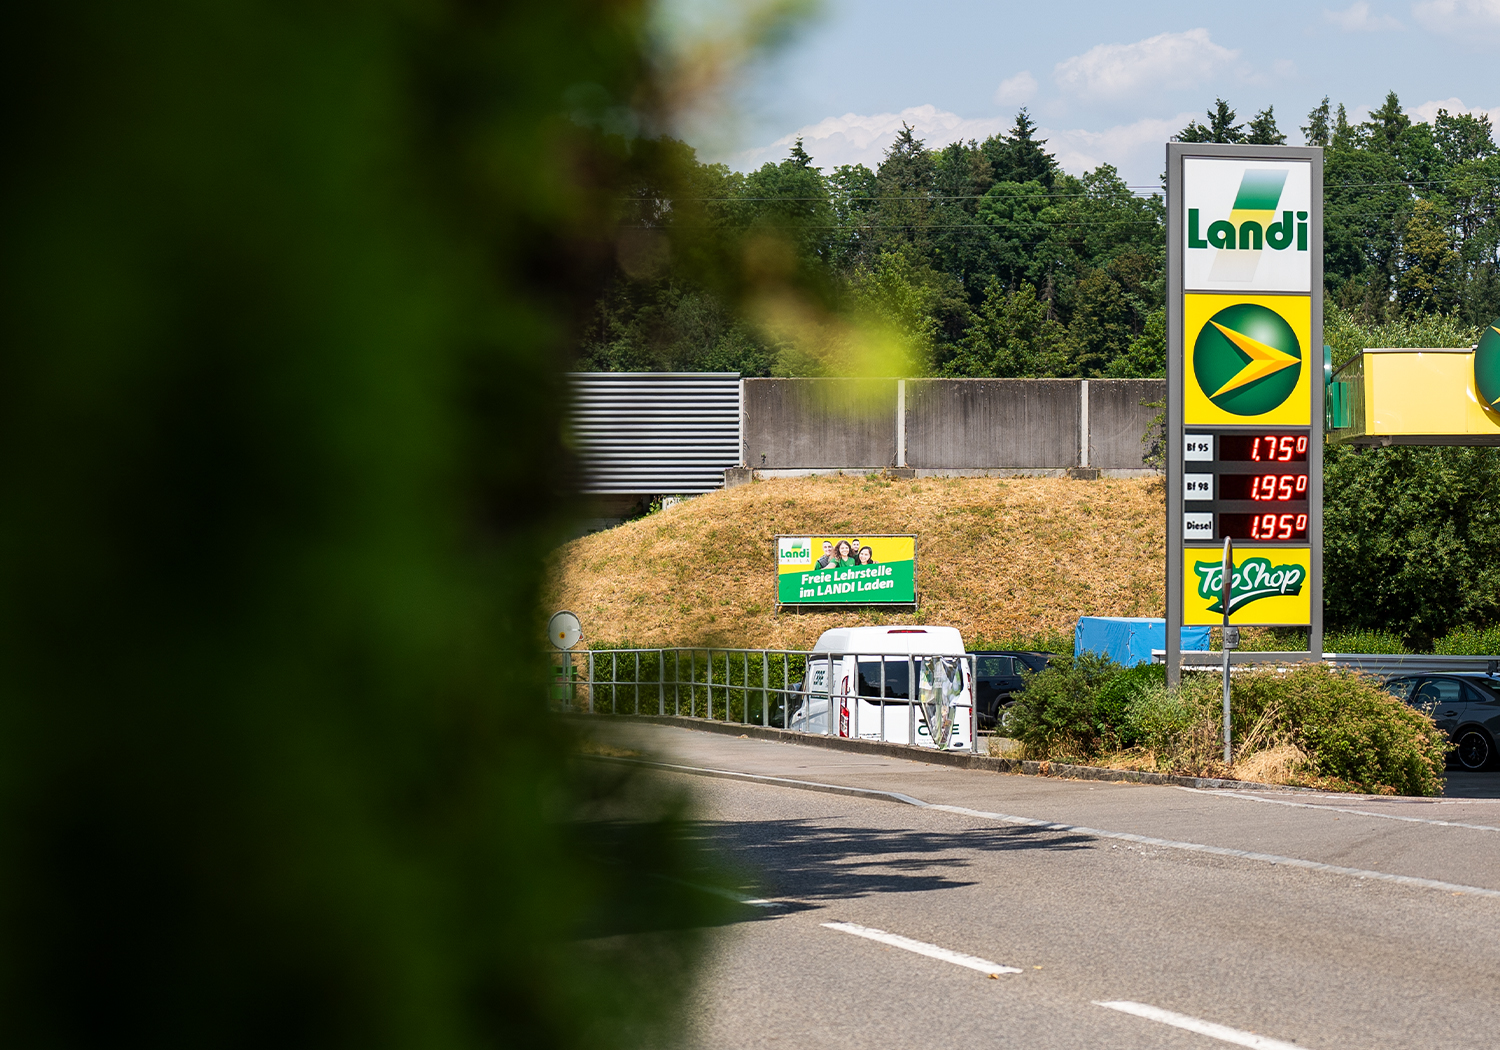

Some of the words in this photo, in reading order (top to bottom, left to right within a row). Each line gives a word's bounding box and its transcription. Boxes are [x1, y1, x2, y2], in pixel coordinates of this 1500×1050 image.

[1188, 208, 1308, 251] Landi
[1187, 443, 1196, 452] Bf
[1198, 443, 1209, 452] 95
[1187, 482, 1196, 491] Bf
[1198, 482, 1209, 491] 98
[1187, 521, 1212, 530] Diesel
[780, 548, 810, 558] Landi
[801, 572, 832, 585] Freie
[833, 565, 893, 582] Lehrstelle
[799, 587, 814, 598] im
[817, 582, 855, 596] LANDI
[857, 579, 894, 592] Laden
